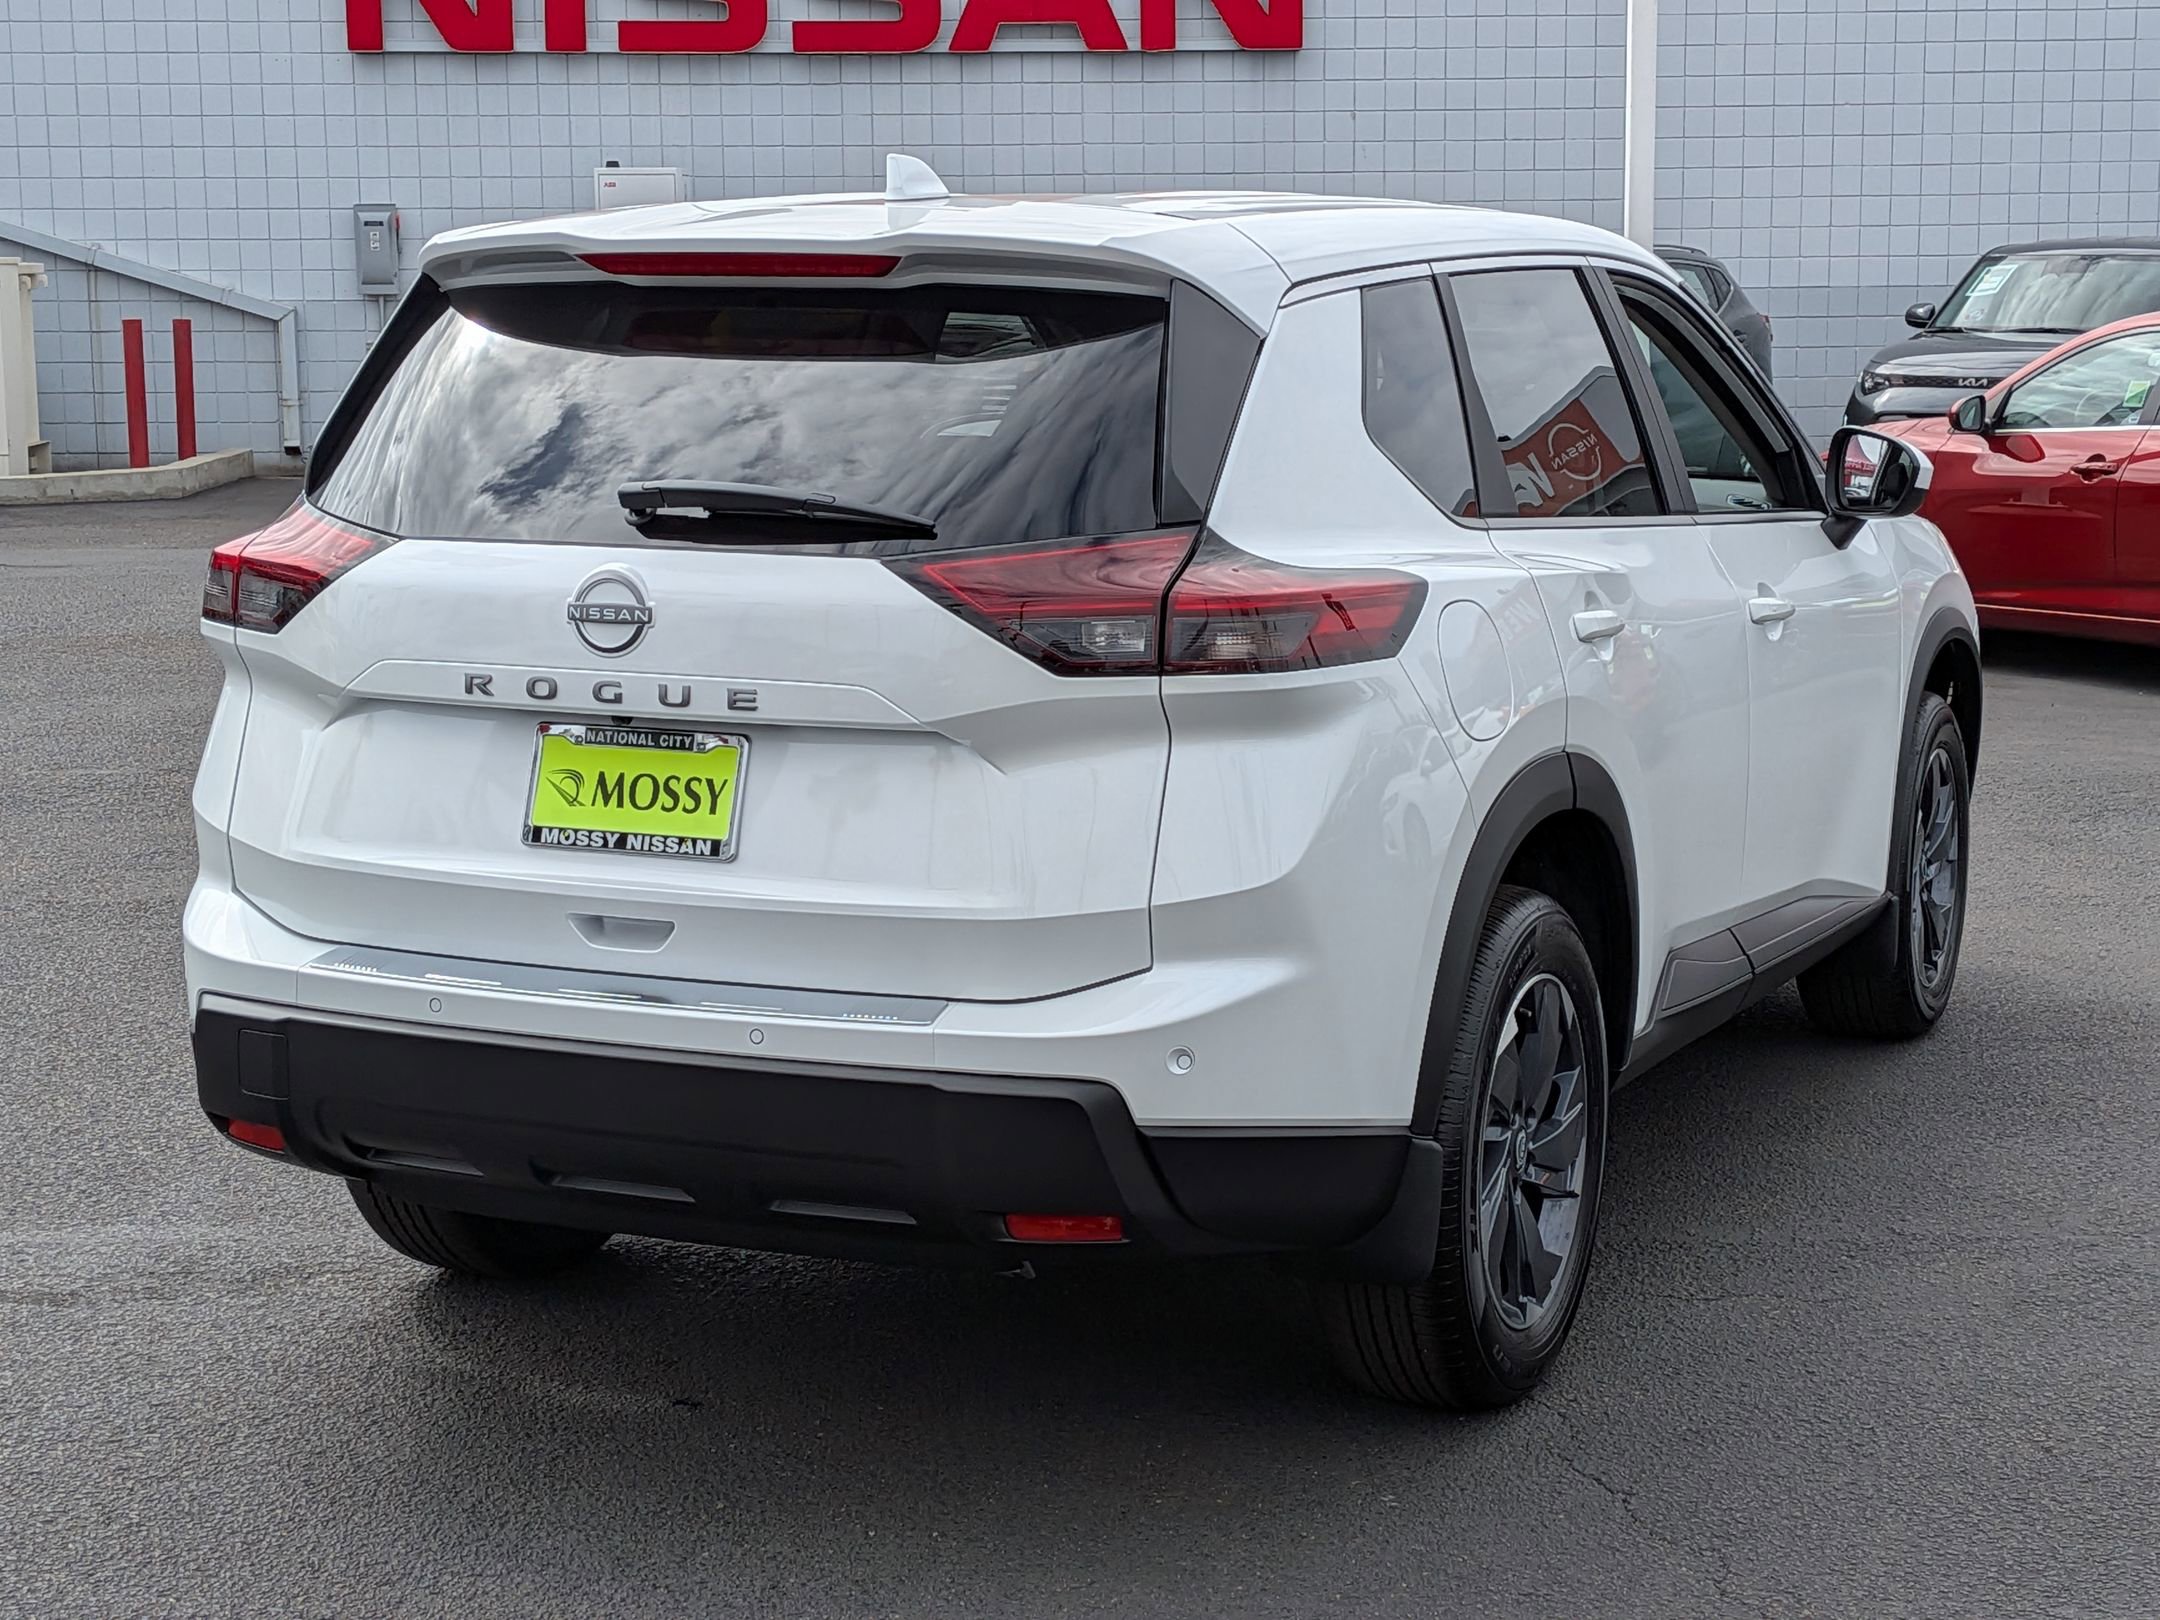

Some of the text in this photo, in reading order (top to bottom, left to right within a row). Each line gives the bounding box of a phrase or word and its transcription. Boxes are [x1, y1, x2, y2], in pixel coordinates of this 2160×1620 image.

[569, 606, 649, 622] NISSAN
[464, 672, 758, 711] ROGUE
[587, 730, 693, 749] NATIONAL CITY
[591, 770, 729, 815] MOSSY
[540, 828, 713, 856] MOSSY NISSAN
